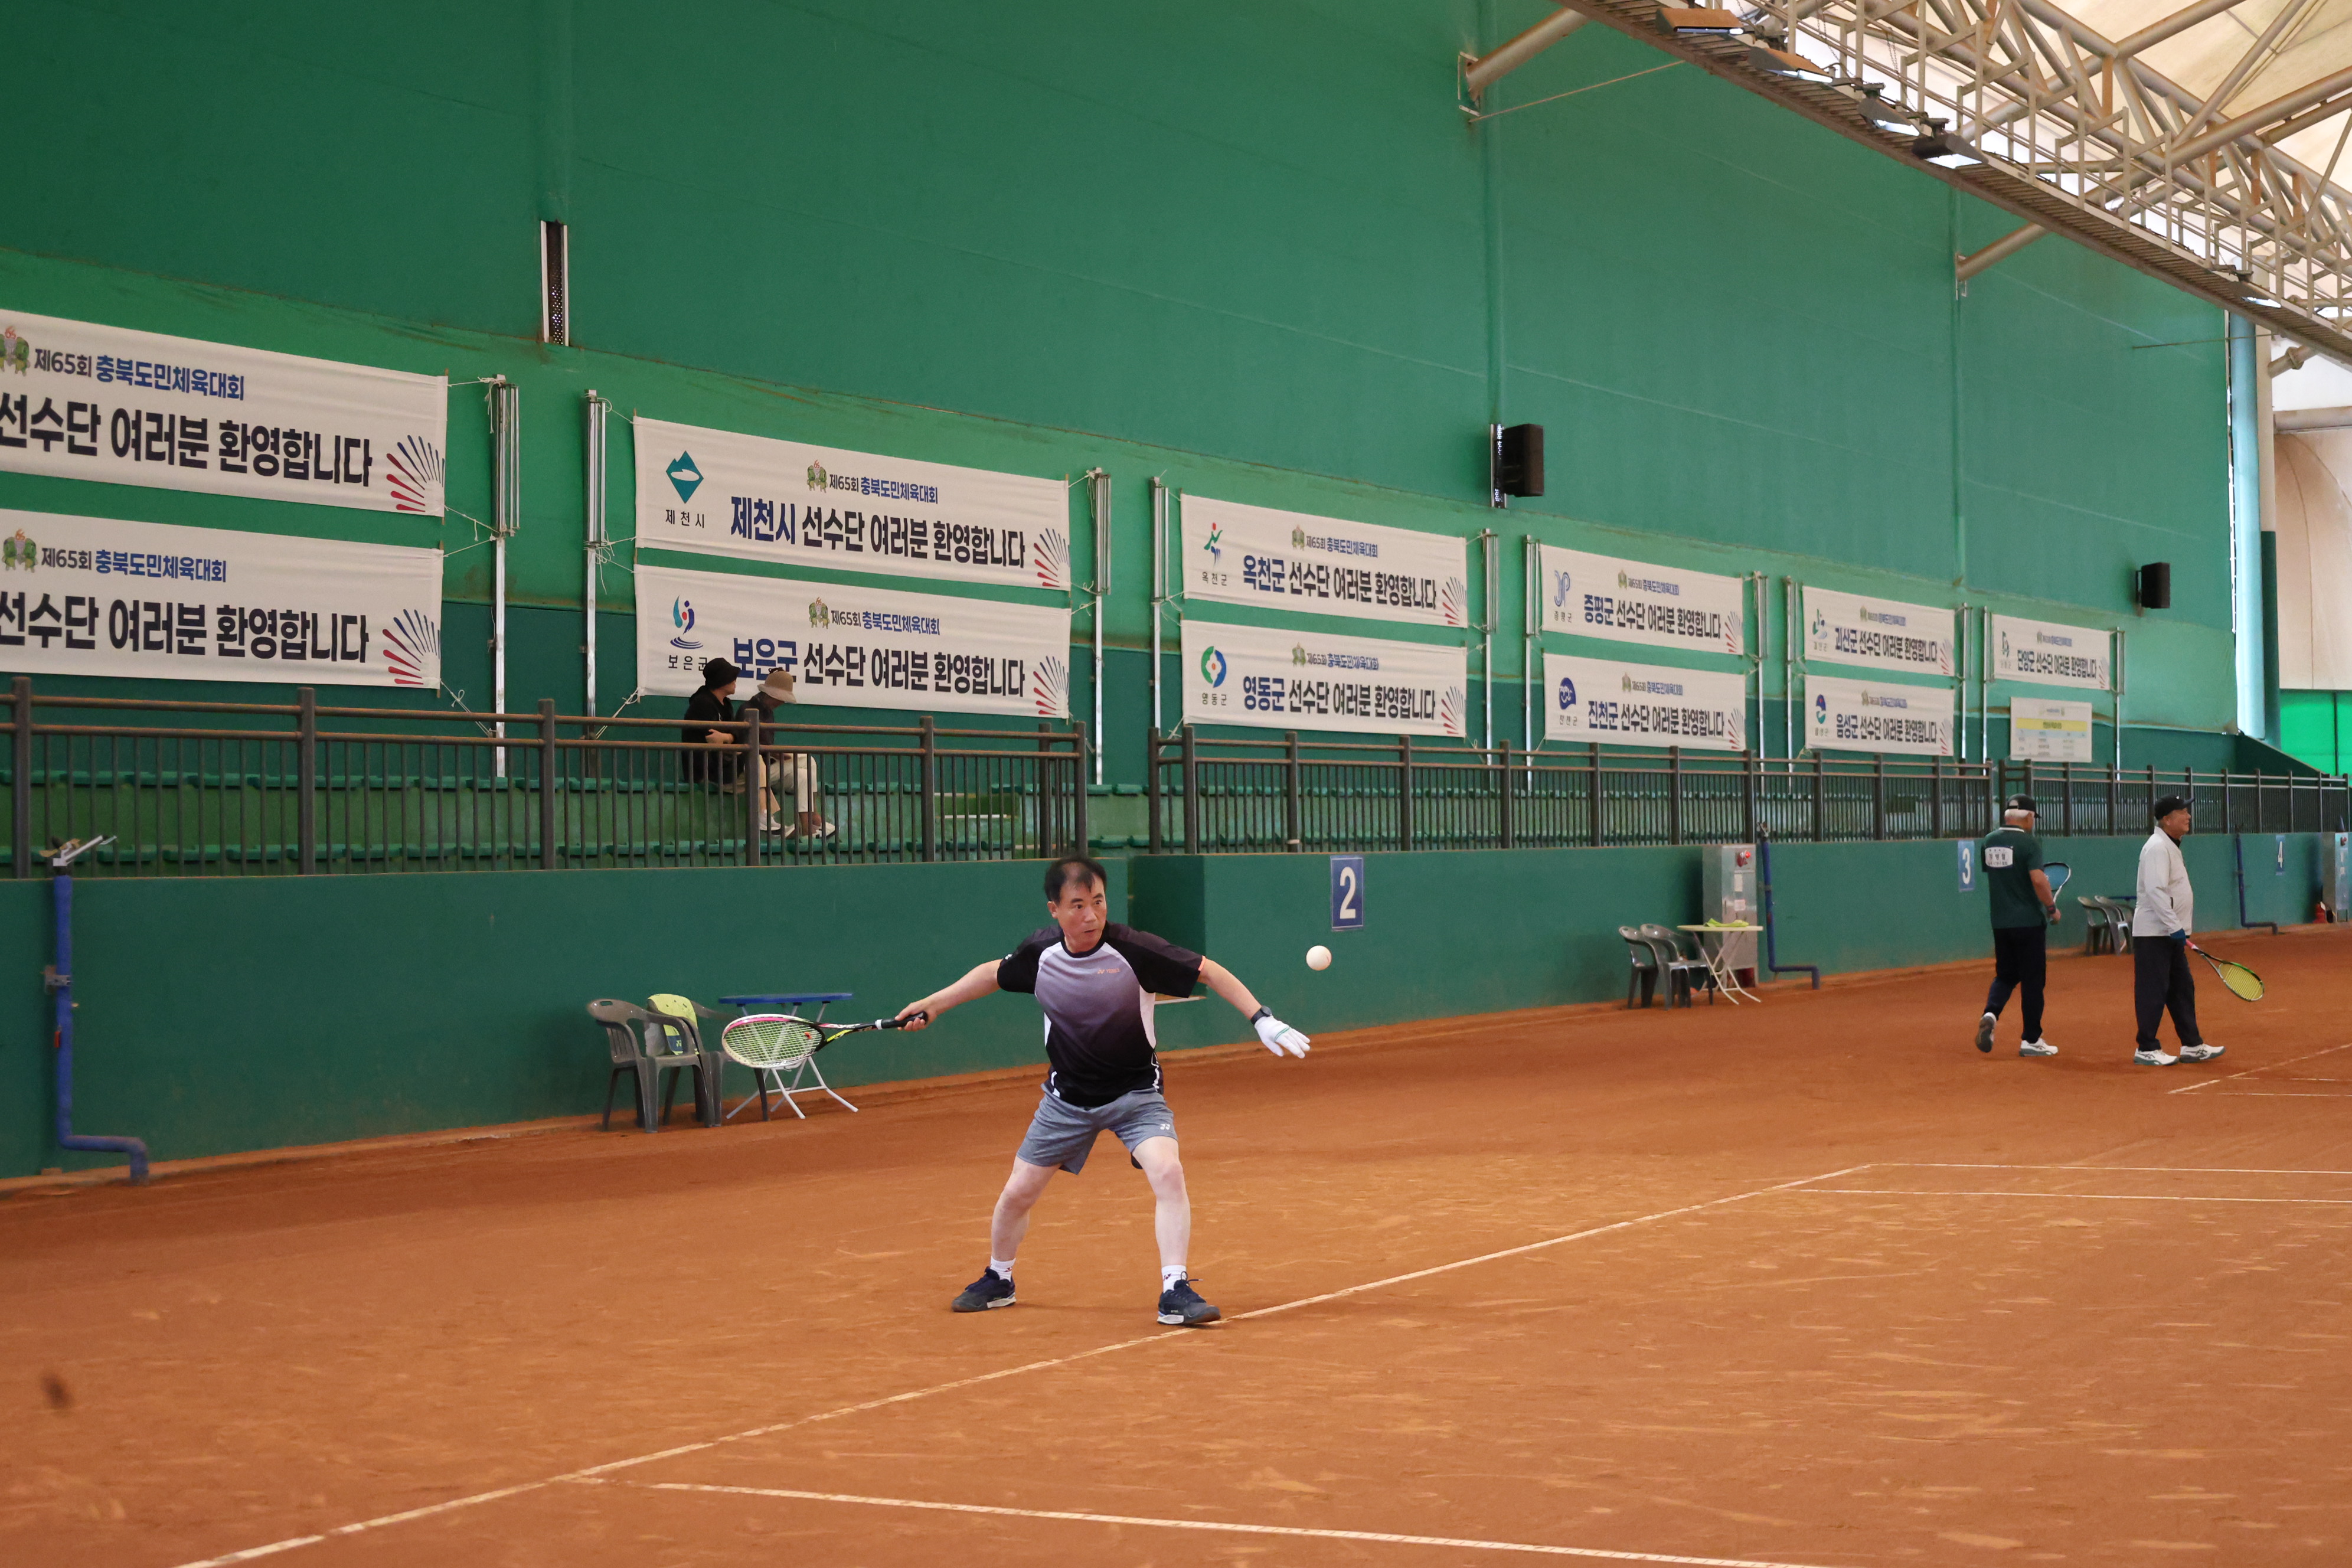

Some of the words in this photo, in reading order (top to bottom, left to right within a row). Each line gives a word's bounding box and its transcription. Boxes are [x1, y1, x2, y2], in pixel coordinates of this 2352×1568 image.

[34, 349, 92, 377] 제65회
[96, 355, 244, 400] 충북도민체육대회
[0, 393, 101, 456] 선수단
[111, 408, 209, 469] 여러분
[219, 420, 373, 487] 환영합니다
[829, 474, 858, 492] 제65회
[861, 477, 937, 504] 충북도민체육대회
[666, 509, 704, 528] 제천시
[731, 496, 795, 544] 제천시
[802, 506, 865, 552] 선수단
[871, 515, 927, 559] 여러분
[933, 521, 1025, 568] 환영합니다
[41, 547, 92, 570] 제65회
[96, 550, 226, 582] 충북도민체육대회
[1306, 536, 1325, 549] 제65회
[1327, 537, 1377, 558] 충북도민체육대회
[1243, 556, 1285, 593] 옥천군
[1289, 562, 1329, 598] 선수단
[1334, 568, 1371, 602] 여러분
[1375, 572, 1436, 609] 환영합니다
[0, 592, 99, 649] 선수단
[109, 599, 207, 655] 여러분
[217, 605, 369, 663] 환영합니다
[831, 610, 861, 626] 제65회
[863, 611, 940, 635] 충북도민체육대회
[1585, 594, 1613, 626] 증평군
[1616, 600, 1645, 630] 선수단
[1648, 605, 1675, 633] 여러분
[1677, 608, 1720, 639] 환영합니다
[733, 638, 798, 682] 보은군
[804, 643, 865, 687] 선수단
[871, 649, 929, 691] 여러분
[935, 652, 1025, 697] 환영합니다
[1307, 653, 1327, 665] 제65회
[1328, 654, 1378, 670] 충북도민체육대회
[1243, 676, 1285, 711] 영동군
[1289, 680, 1329, 714] 선수단
[1334, 684, 1370, 716] 여러분
[1375, 685, 1435, 720] 환영합니다
[1589, 701, 1618, 730] 진천군
[1621, 704, 1649, 732] 선수단
[1652, 707, 1679, 734] 여러분
[1681, 708, 1724, 737] 환영합니다
[1837, 714, 1858, 739] 음성군
[1860, 717, 1881, 740] 선수단
[1883, 718, 1903, 741] 여러분
[1905, 719, 1937, 743] 환영합니다
[1962, 848, 1971, 884] 3
[2276, 841, 2284, 868] 4
[1340, 866, 1356, 919] 2
